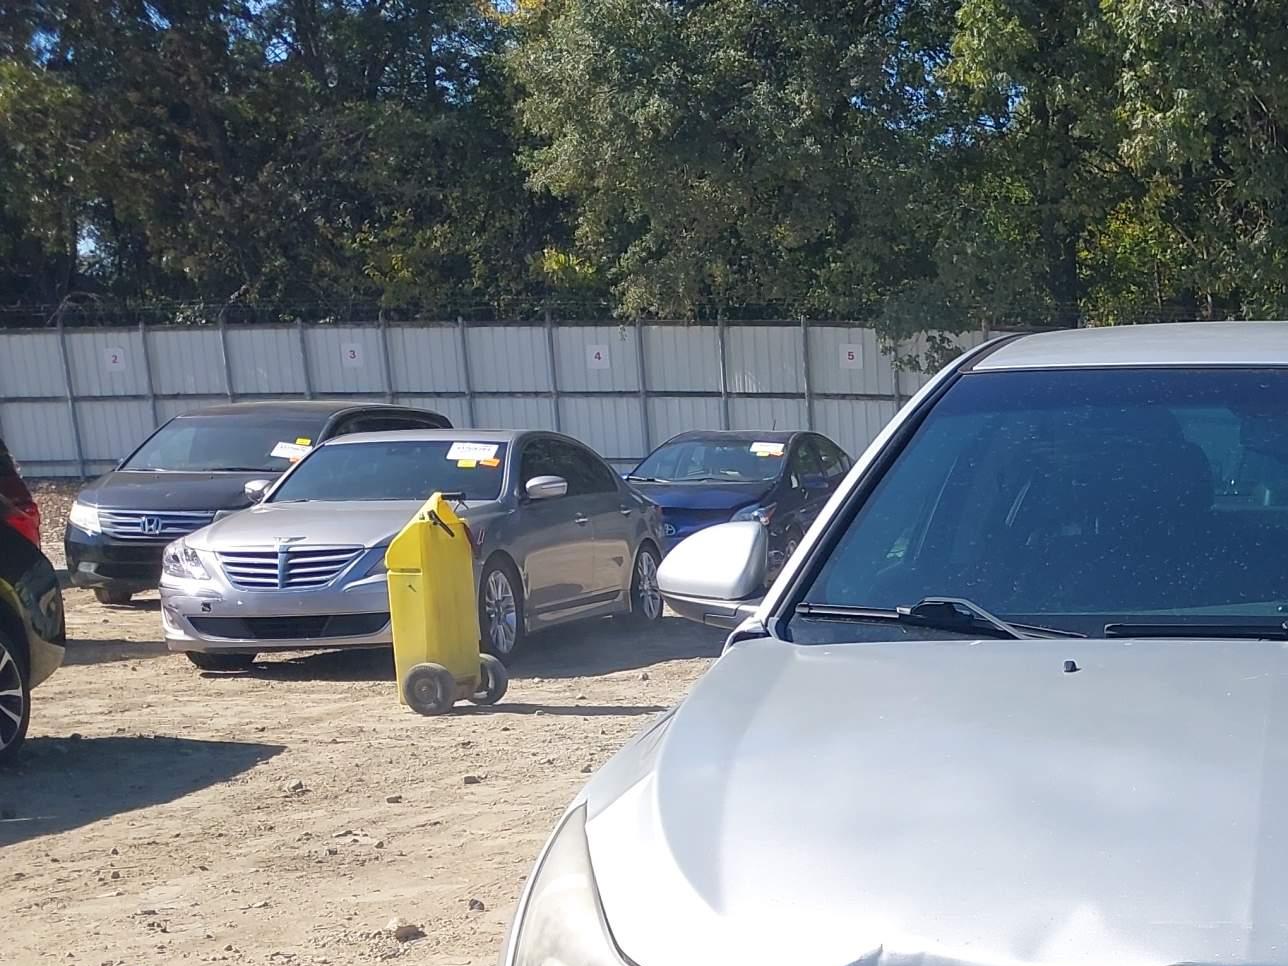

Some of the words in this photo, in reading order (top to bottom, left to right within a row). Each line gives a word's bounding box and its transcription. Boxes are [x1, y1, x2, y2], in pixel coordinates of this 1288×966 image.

[111, 354, 119, 364] 2
[349, 350, 356, 360] 3
[594, 351, 602, 361] 4
[847, 351, 855, 361] 5
